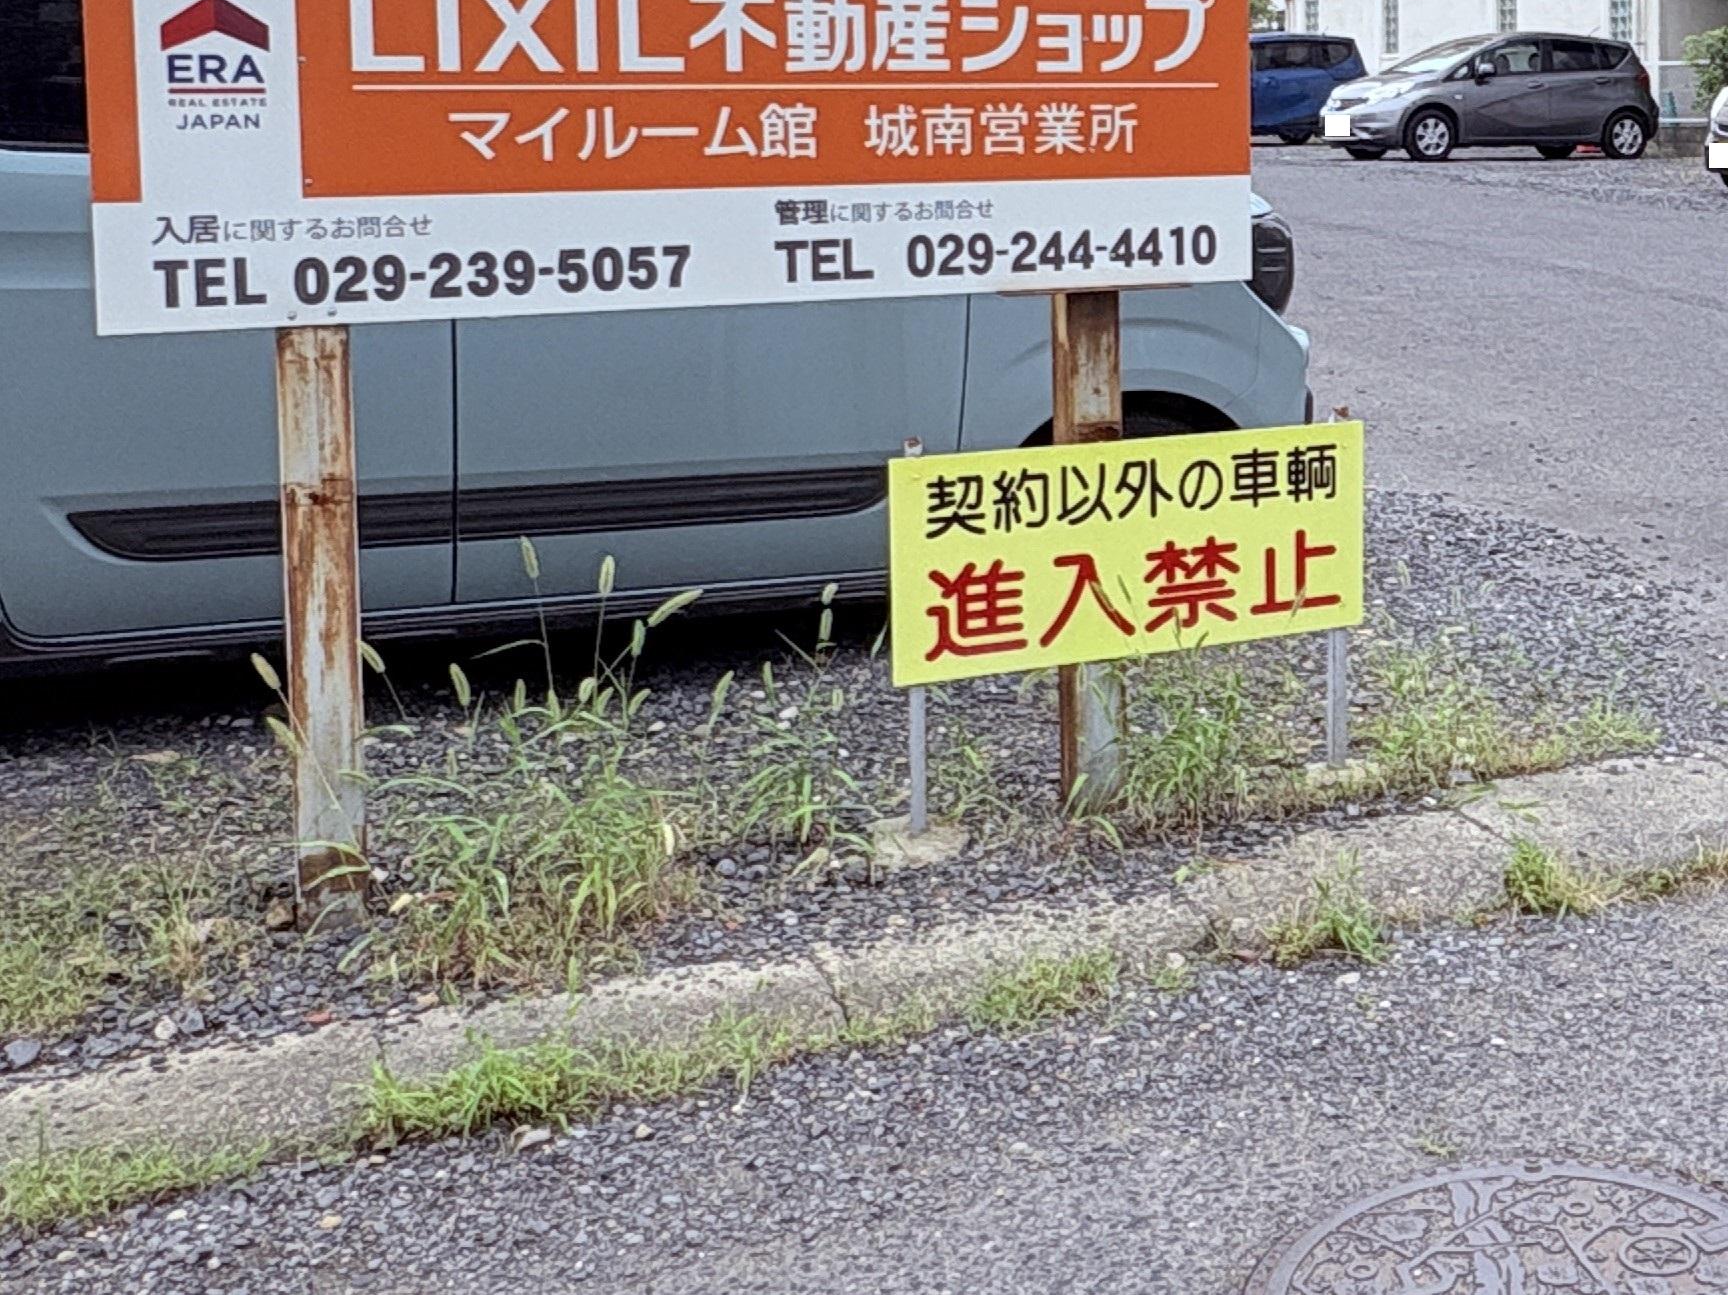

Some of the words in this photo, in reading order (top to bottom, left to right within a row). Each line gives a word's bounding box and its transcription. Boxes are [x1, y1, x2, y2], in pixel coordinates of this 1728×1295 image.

[167, 54, 265, 84] ERA
[176, 113, 260, 130] JAPAN
[448, 103, 818, 162] マイルーム館
[864, 101, 1139, 156] 城南営業所
[152, 213, 433, 245] 入居に関するお問合せ
[774, 198, 994, 226] 管理に関するお問合せ
[153, 256, 267, 308] TEL
[293, 244, 692, 306] 029-239-5057
[774, 238, 874, 283] TEL
[906, 224, 1217, 279] 029-244-4410
[925, 529, 1342, 663] 進入禁止
